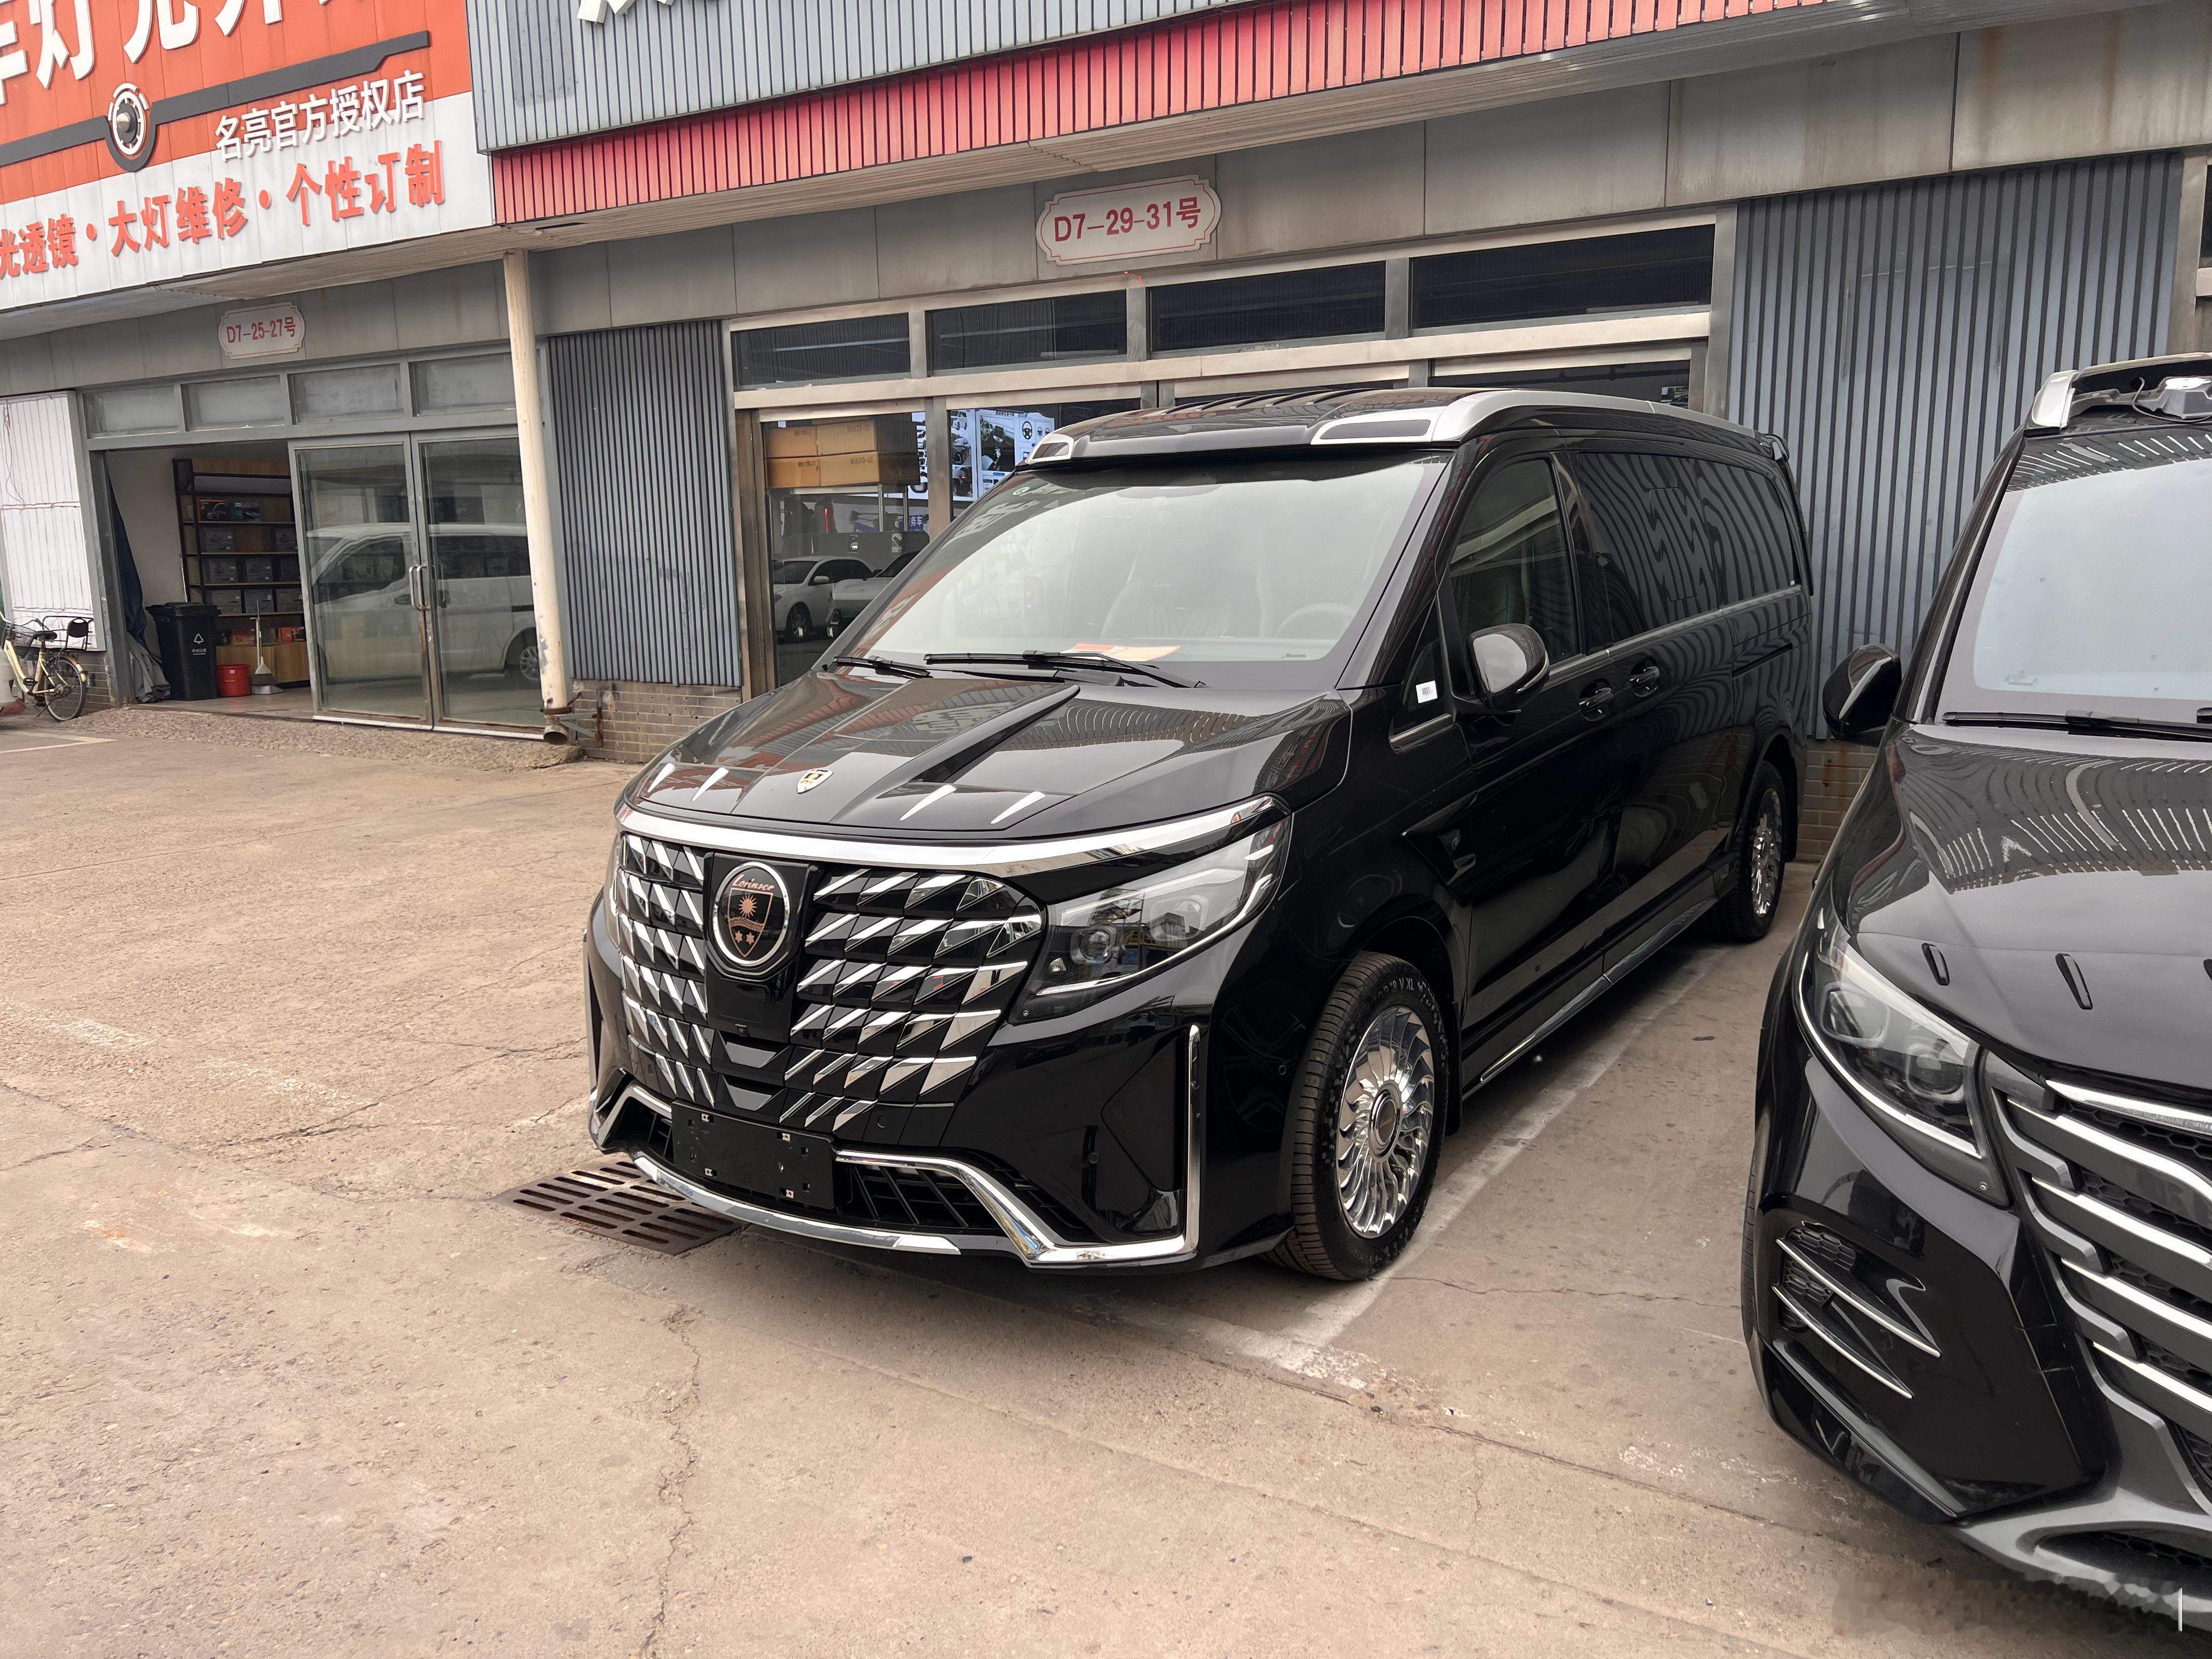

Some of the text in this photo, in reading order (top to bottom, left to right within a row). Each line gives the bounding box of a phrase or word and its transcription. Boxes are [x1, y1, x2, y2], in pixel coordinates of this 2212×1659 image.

[215, 69, 425, 162] 名亮官方授权店
[1054, 196, 1201, 242] D7-29-31号
[226, 316, 296, 343] D7-25-27号
[909, 516, 923, 527] 务车
[732, 874, 775, 891] Lorinser
